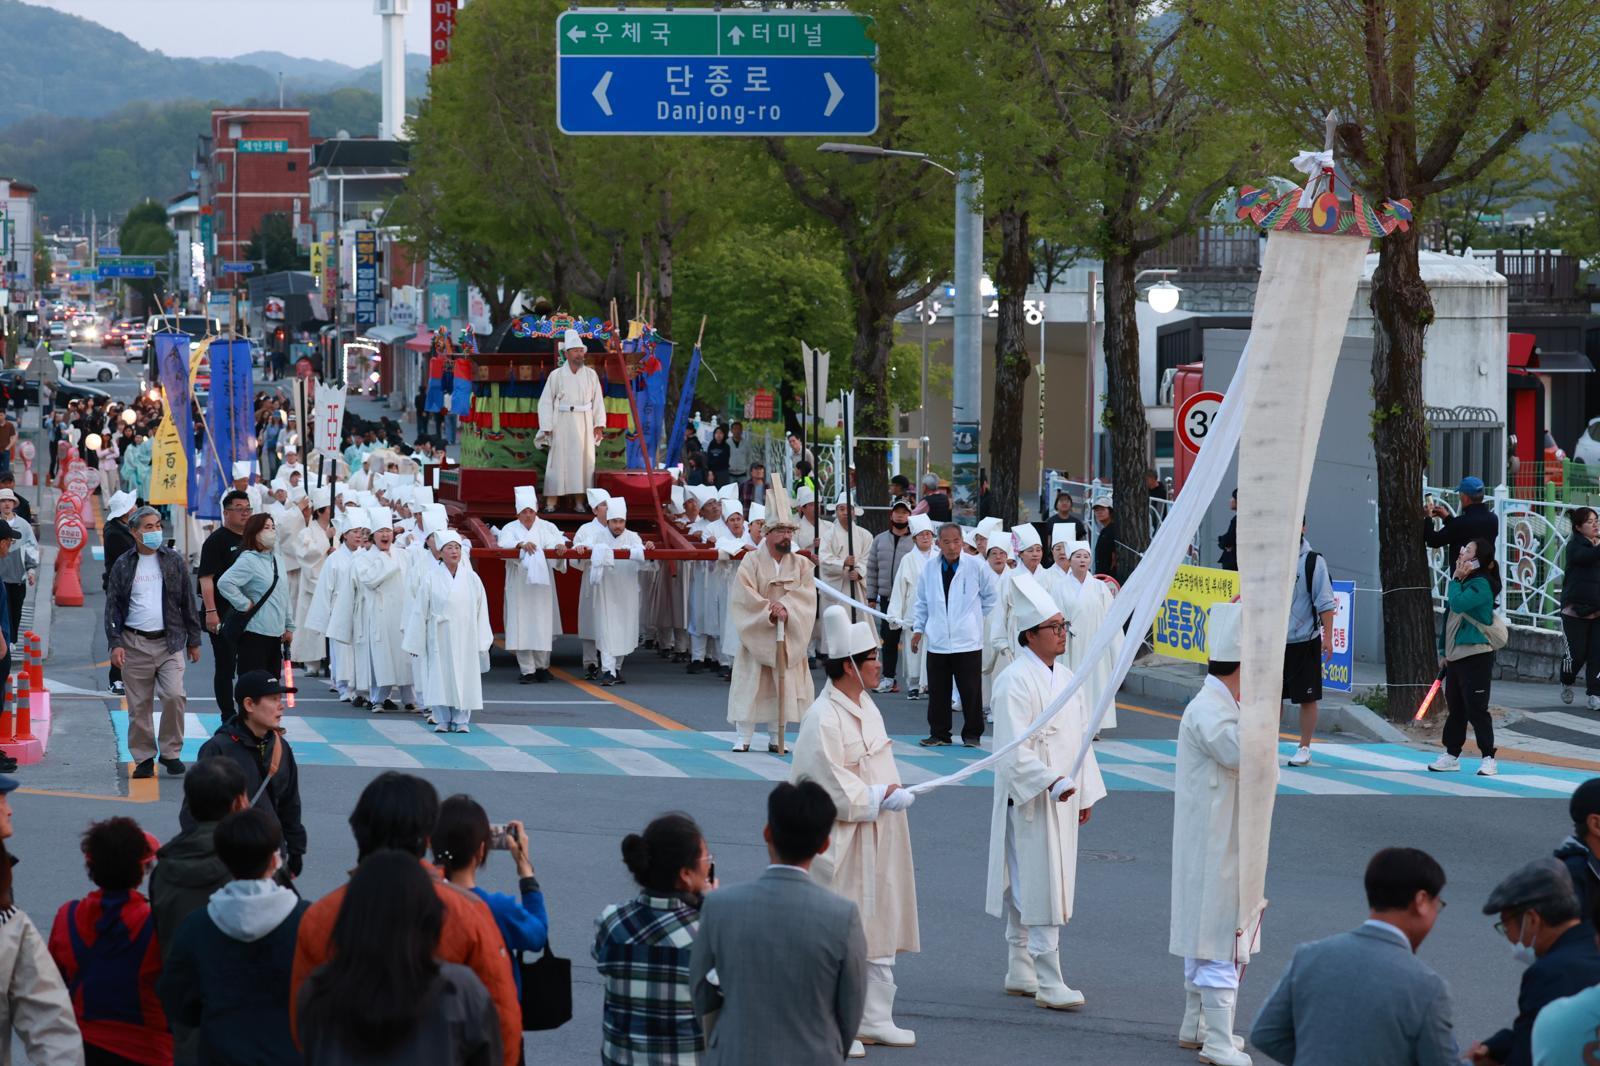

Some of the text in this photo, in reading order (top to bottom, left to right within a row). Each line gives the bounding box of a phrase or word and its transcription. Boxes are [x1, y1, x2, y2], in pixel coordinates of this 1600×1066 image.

[591, 22, 671, 46] 우체국
[752, 23, 821, 47] 터미널
[666, 65, 771, 97] 단종로
[657, 101, 781, 125] Danjong-ro
